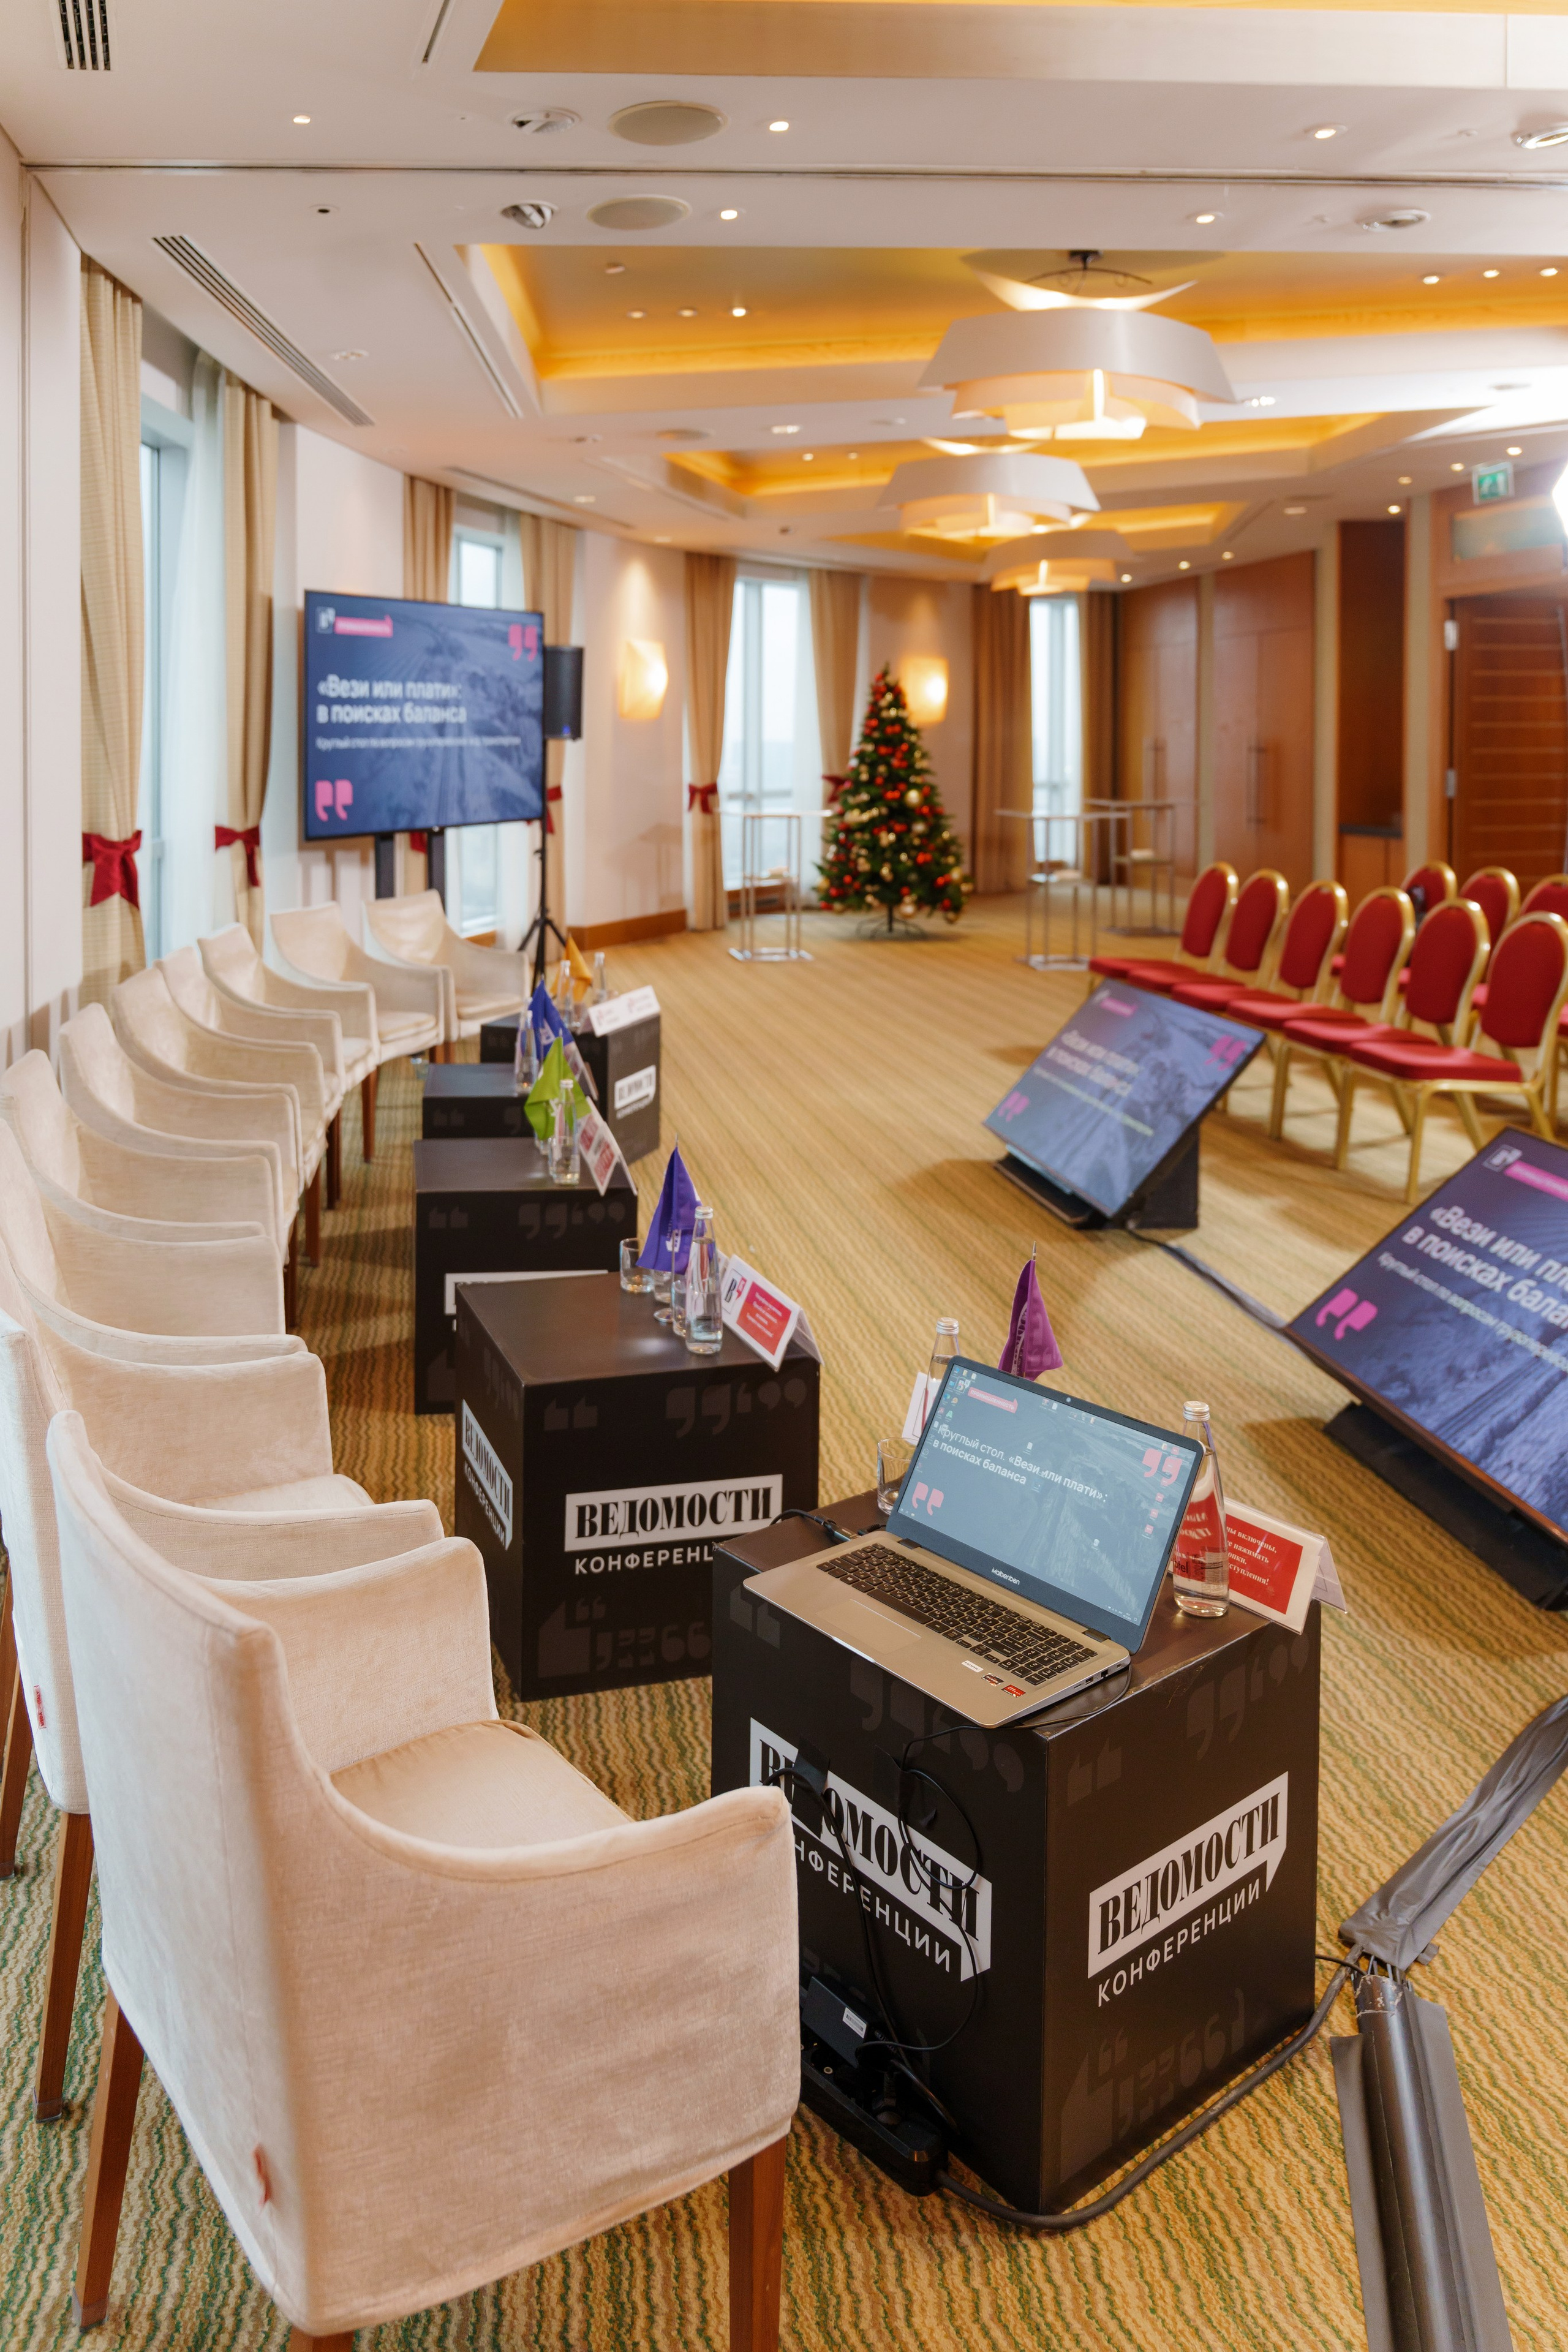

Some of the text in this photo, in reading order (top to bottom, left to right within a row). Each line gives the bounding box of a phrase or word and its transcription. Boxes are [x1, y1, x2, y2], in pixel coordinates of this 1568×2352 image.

[372, 680, 403, 698] или
[317, 704, 328, 723] в
[331, 704, 401, 724] поисках
[1402, 1226, 1425, 1245] в
[1416, 1233, 1514, 1292] поисках
[1430, 1205, 1497, 1248] «Вези
[1489, 1236, 1542, 1270] или
[970, 1389, 1015, 1411] ПРОМЫШЛЕННОСТЬ
[466, 1414, 510, 1521] ВЕДОМОСТИ
[932, 1439, 1027, 1485] в поисках баланса
[938, 1425, 979, 1449] Круглый
[979, 1444, 1006, 1461] стол.
[1008, 1455, 1040, 1474] «Вези
[1063, 1477, 1108, 1502] плати»:
[575, 1486, 774, 1539] ВЕДОМОСТИ
[575, 1547, 713, 1575] КОНФЕРЕНЦ
[1228, 1552, 1247, 1565] опки.
[1233, 1542, 1270, 1563] нажимать
[1237, 1531, 1277, 1554] включены,
[991, 1567, 1020, 1585] Maibenben
[1228, 1562, 1270, 1585] ступления!
[759, 1738, 980, 1942] ВОМОСТИ
[1098, 1792, 1280, 1955] ВЕДОМОСТИ
[794, 1841, 951, 1973] НФЕРЕНЦИИ
[1098, 1878, 1259, 2008] КОНФЕРЕНЦИИ
